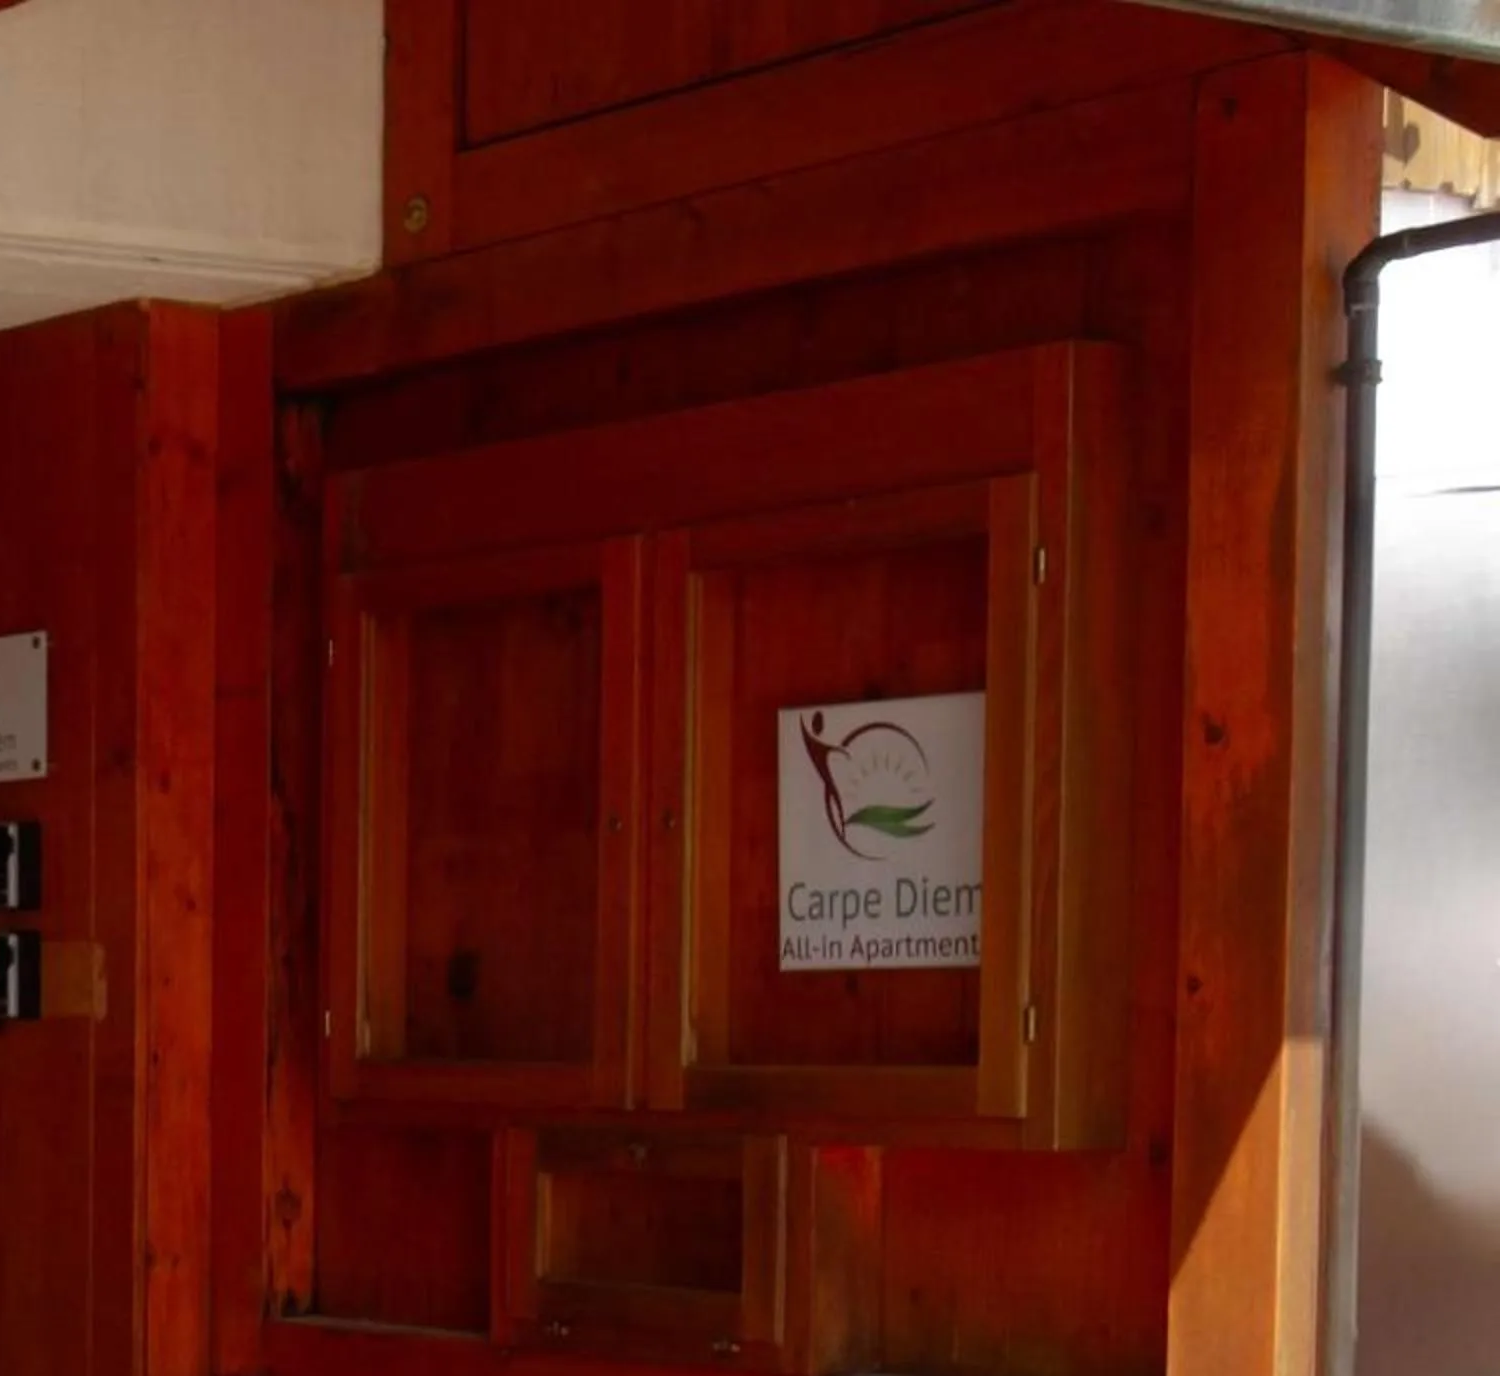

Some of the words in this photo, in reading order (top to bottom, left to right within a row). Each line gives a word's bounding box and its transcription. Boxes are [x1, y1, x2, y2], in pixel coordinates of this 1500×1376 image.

[788, 881, 882, 931] Carpe
[895, 876, 984, 919] Diem
[782, 934, 843, 961] All-in
[850, 932, 981, 964] Apartment
